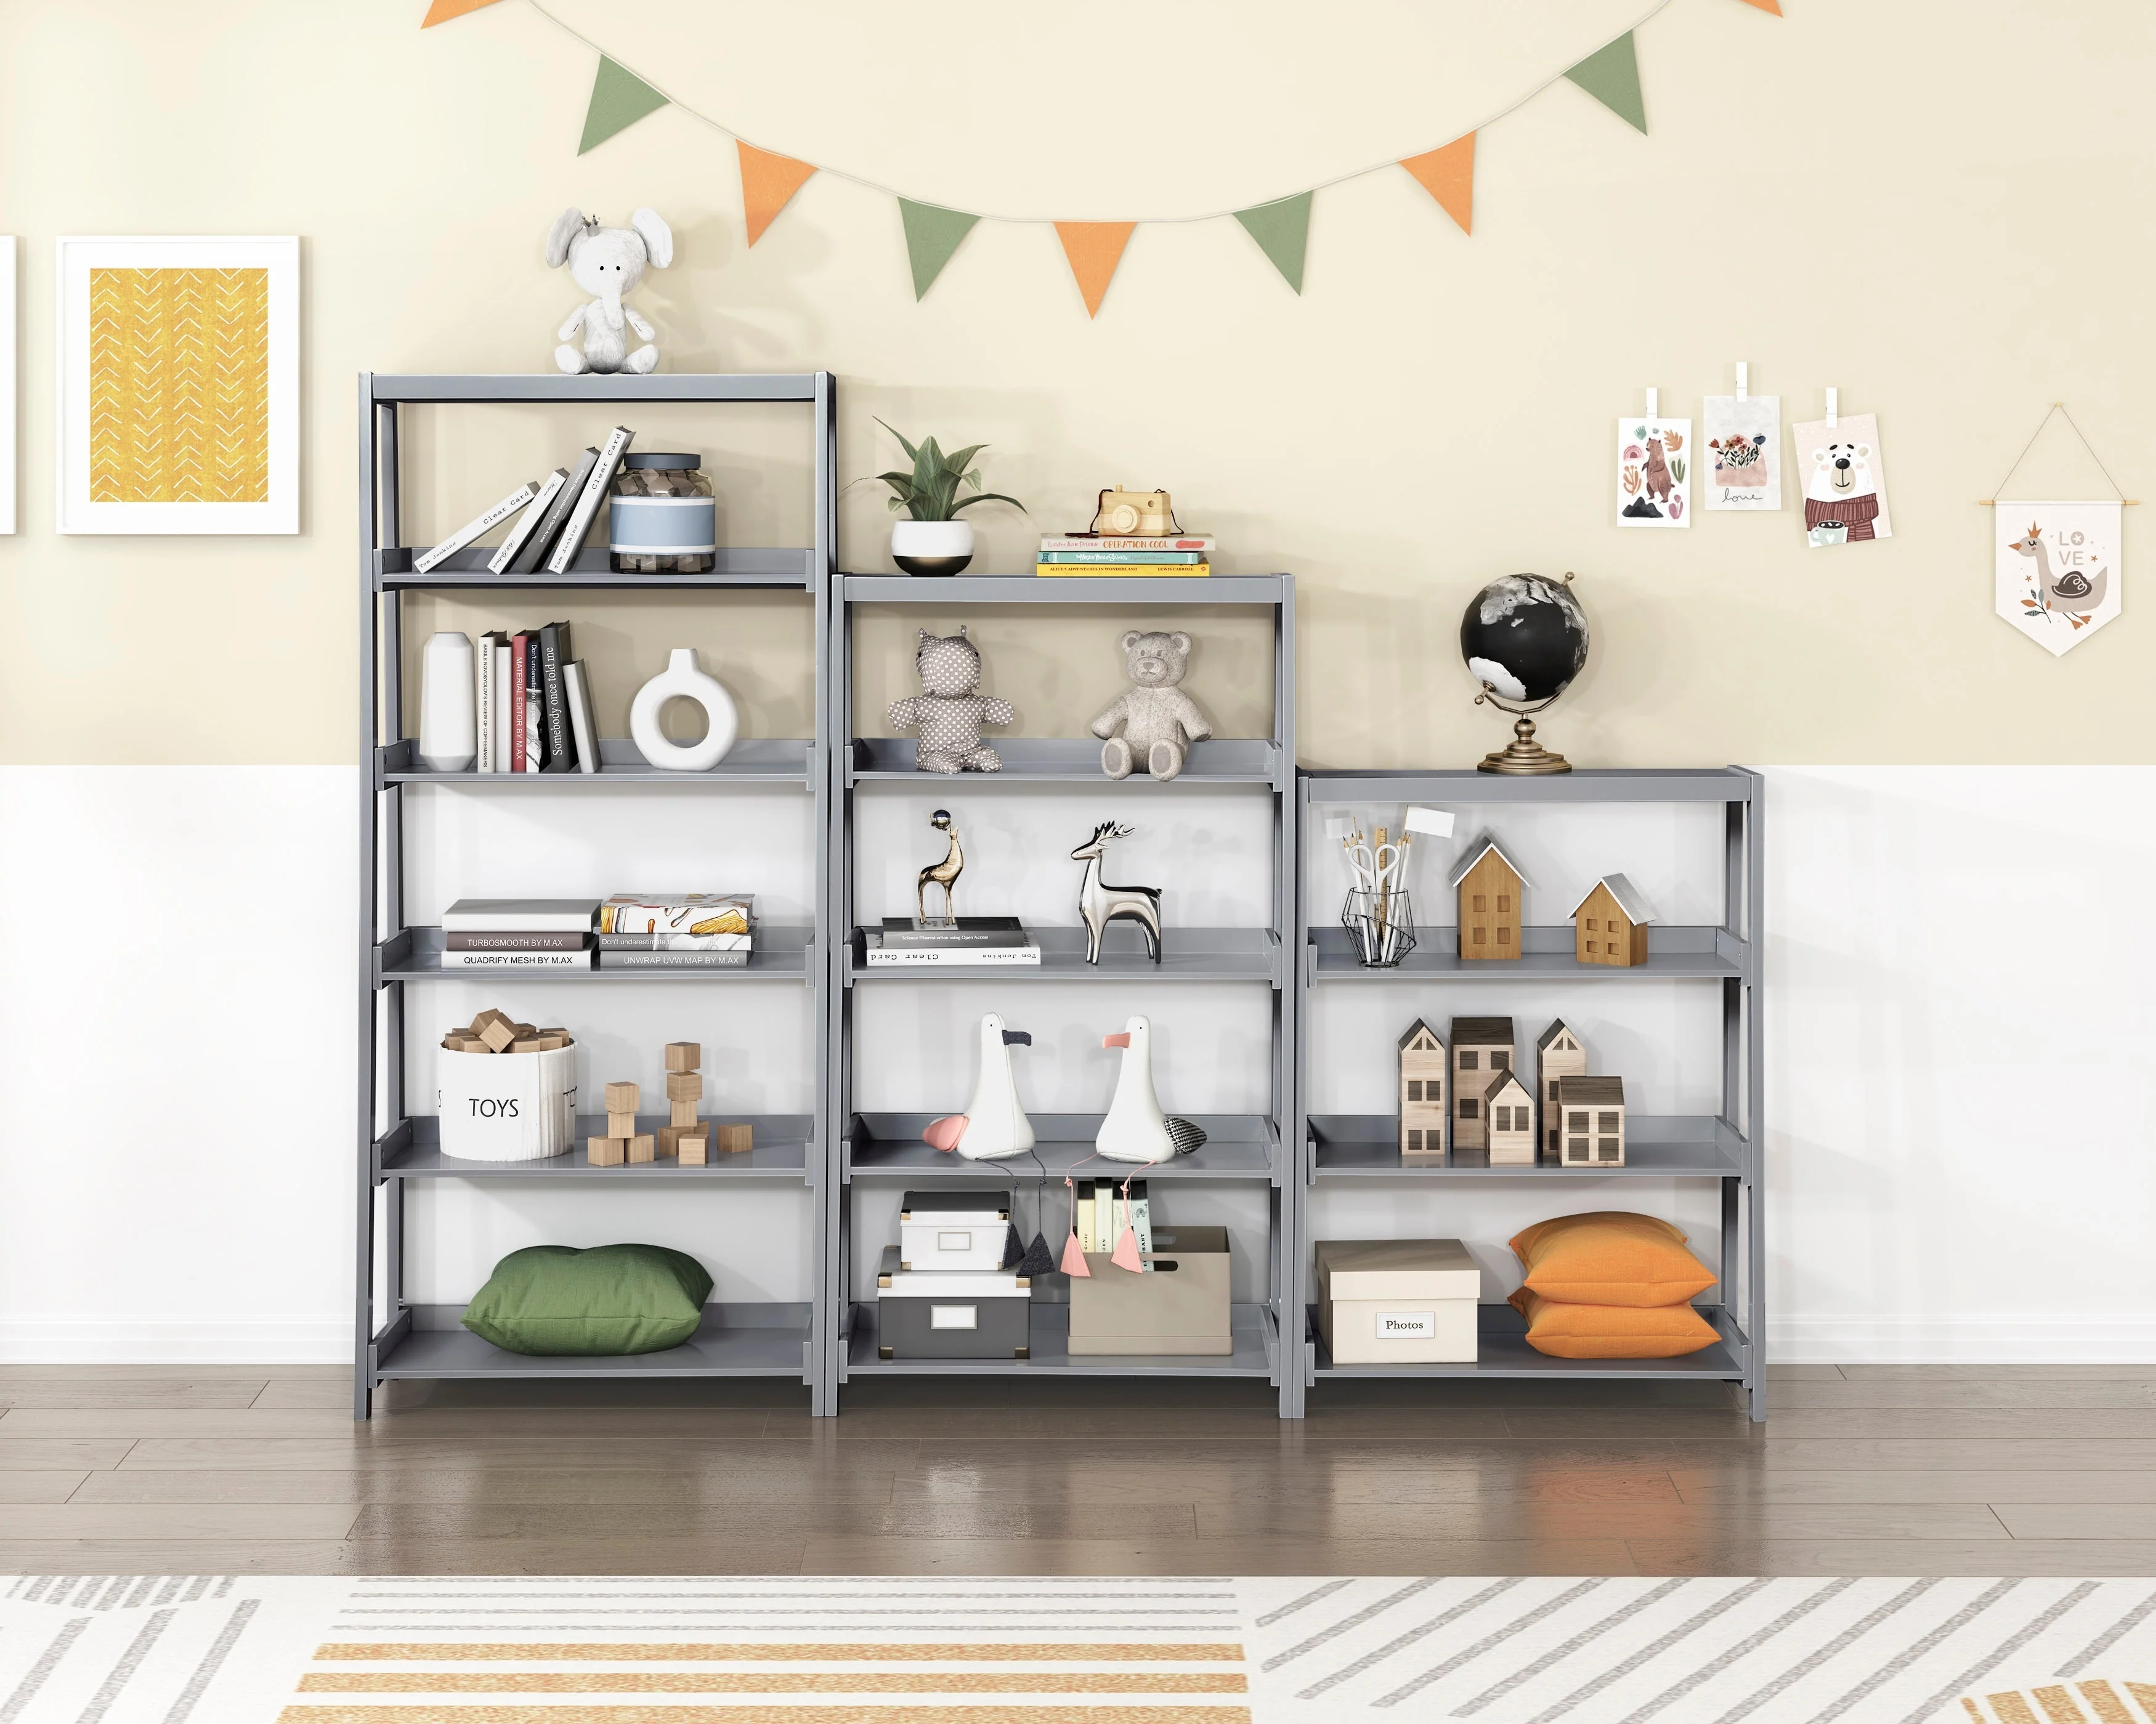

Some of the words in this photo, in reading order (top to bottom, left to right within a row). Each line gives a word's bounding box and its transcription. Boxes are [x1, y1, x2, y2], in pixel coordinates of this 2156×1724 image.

[591, 462, 608, 490] Clear
[607, 433, 622, 456] Card
[575, 469, 585, 484] Science
[559, 484, 577, 510] Dissemination
[483, 507, 506, 524] Clear
[510, 491, 529, 506] Card
[553, 509, 561, 520] using
[548, 519, 556, 530] Open
[540, 530, 549, 543] Access
[2059, 531, 2085, 546] LO
[554, 556, 562, 569] Tom
[562, 524, 578, 553] Jenkins
[419, 560, 431, 569] Tom
[433, 541, 456, 560] Jenkins
[2058, 551, 2084, 565] VE
[546, 647, 554, 662] me
[545, 663, 556, 681] told
[549, 684, 558, 705] once
[516, 728, 523, 739] BY
[549, 708, 563, 755] Somebody
[469, 1098, 518, 1117] TOYS
[1386, 1320, 1424, 1329] Photos
